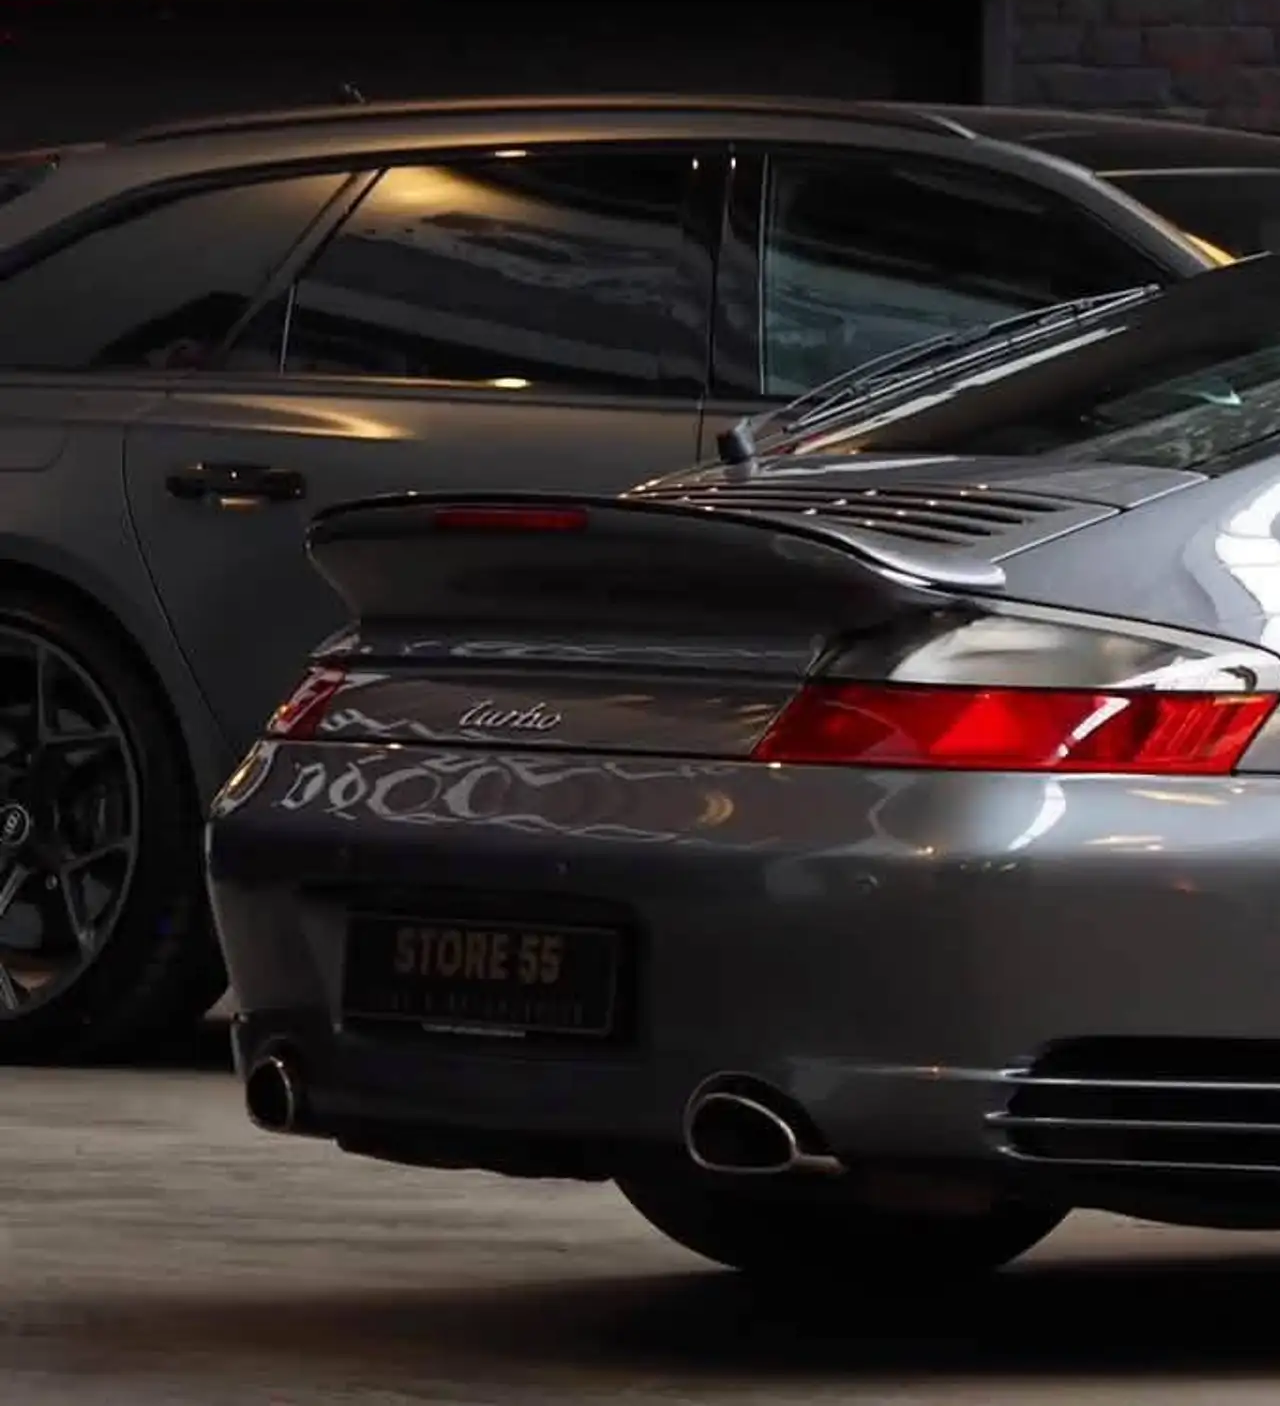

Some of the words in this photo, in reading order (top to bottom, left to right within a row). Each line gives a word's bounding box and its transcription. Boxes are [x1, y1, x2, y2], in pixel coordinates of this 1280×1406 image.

[460, 699, 561, 730] turbo
[394, 926, 509, 980] STORE
[518, 932, 566, 985] 55
